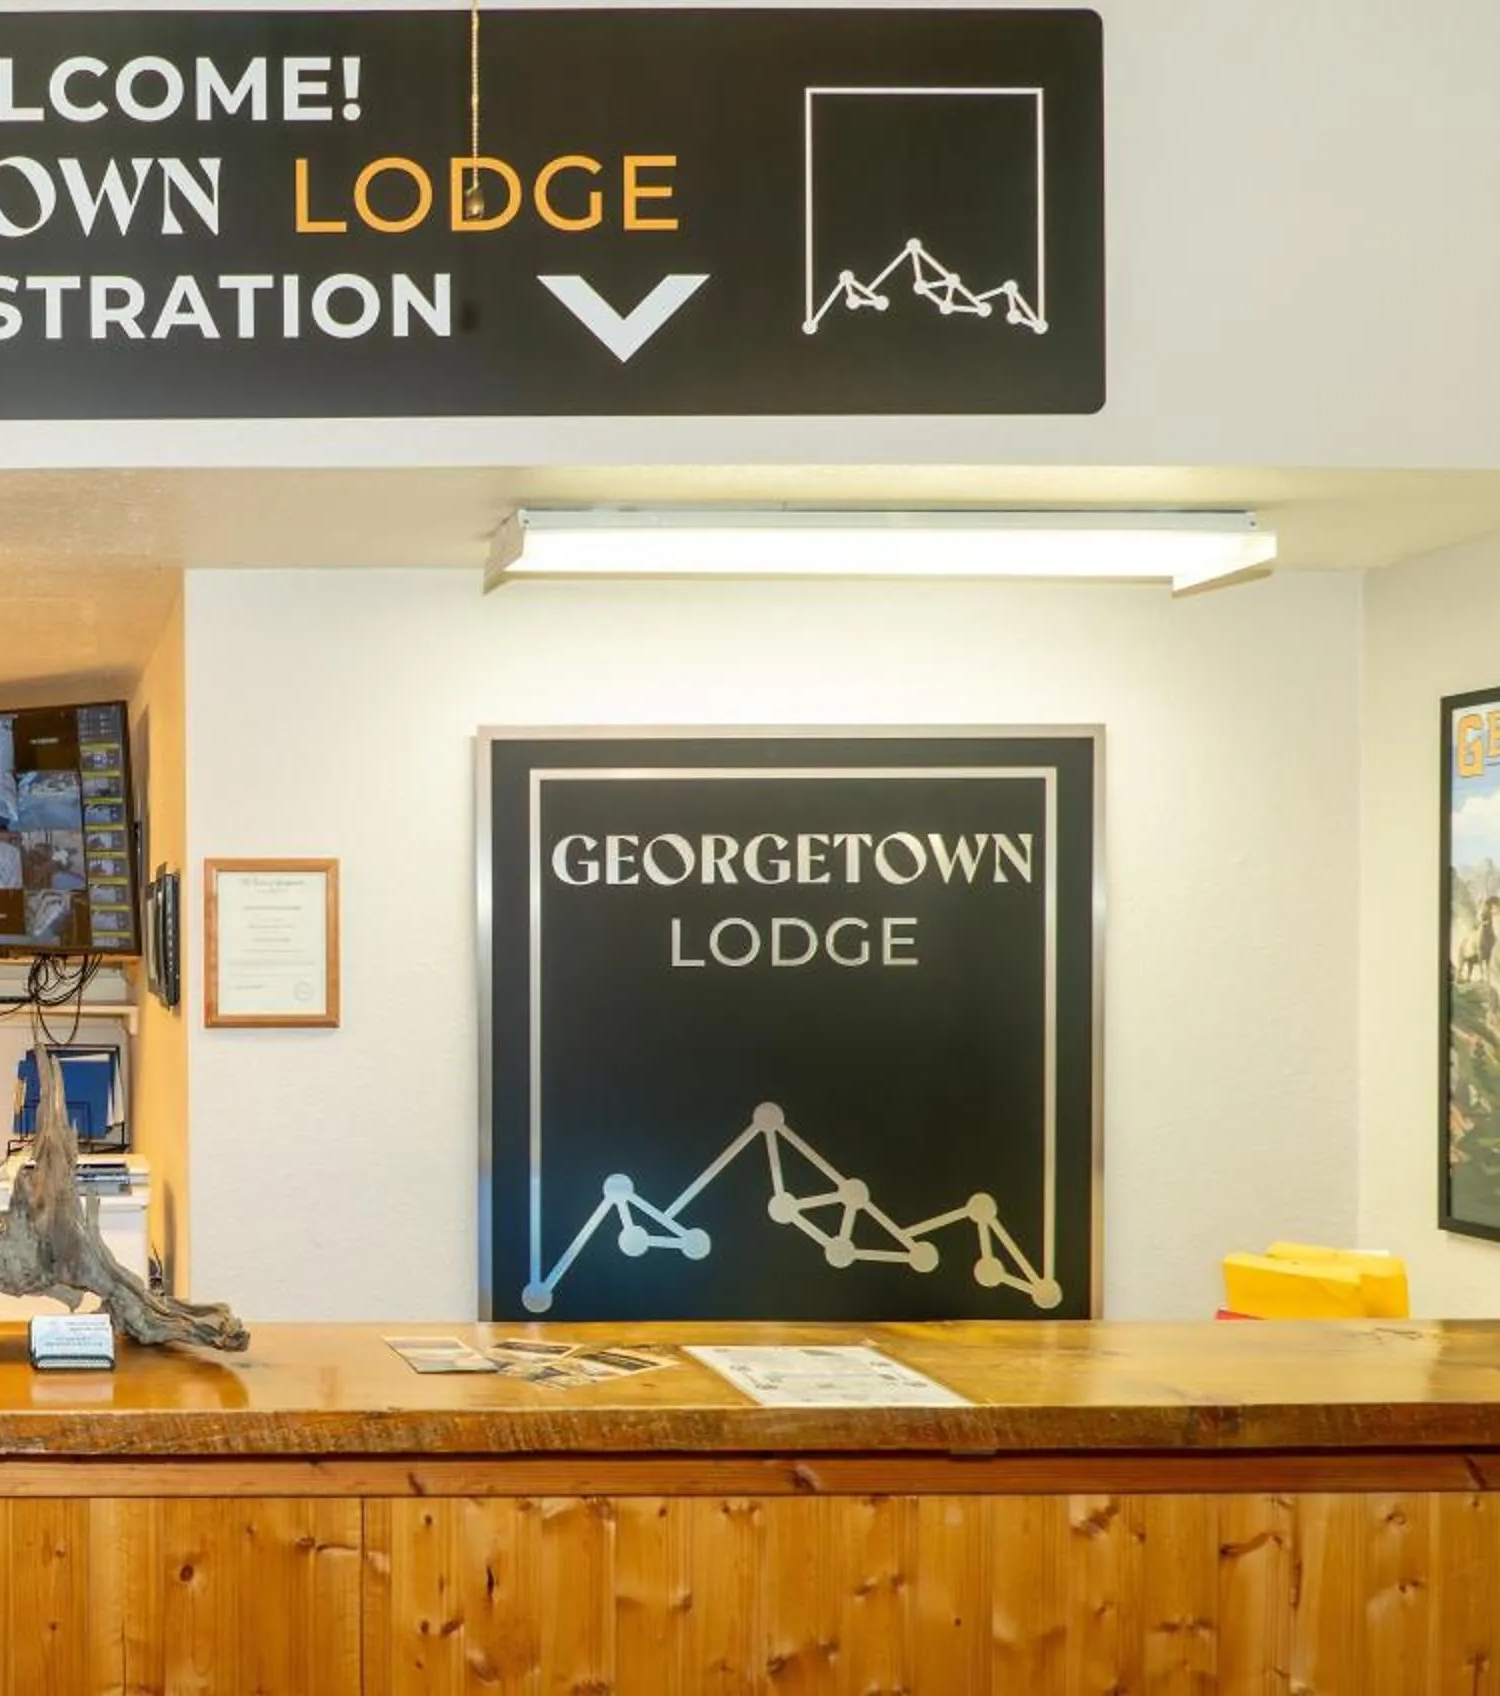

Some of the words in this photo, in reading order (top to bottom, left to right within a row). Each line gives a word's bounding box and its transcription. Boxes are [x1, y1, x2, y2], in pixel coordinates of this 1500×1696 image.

[294, 154, 679, 235] LODGE
[551, 831, 1033, 887] GEORGETOWN
[670, 916, 920, 968] LODGE
